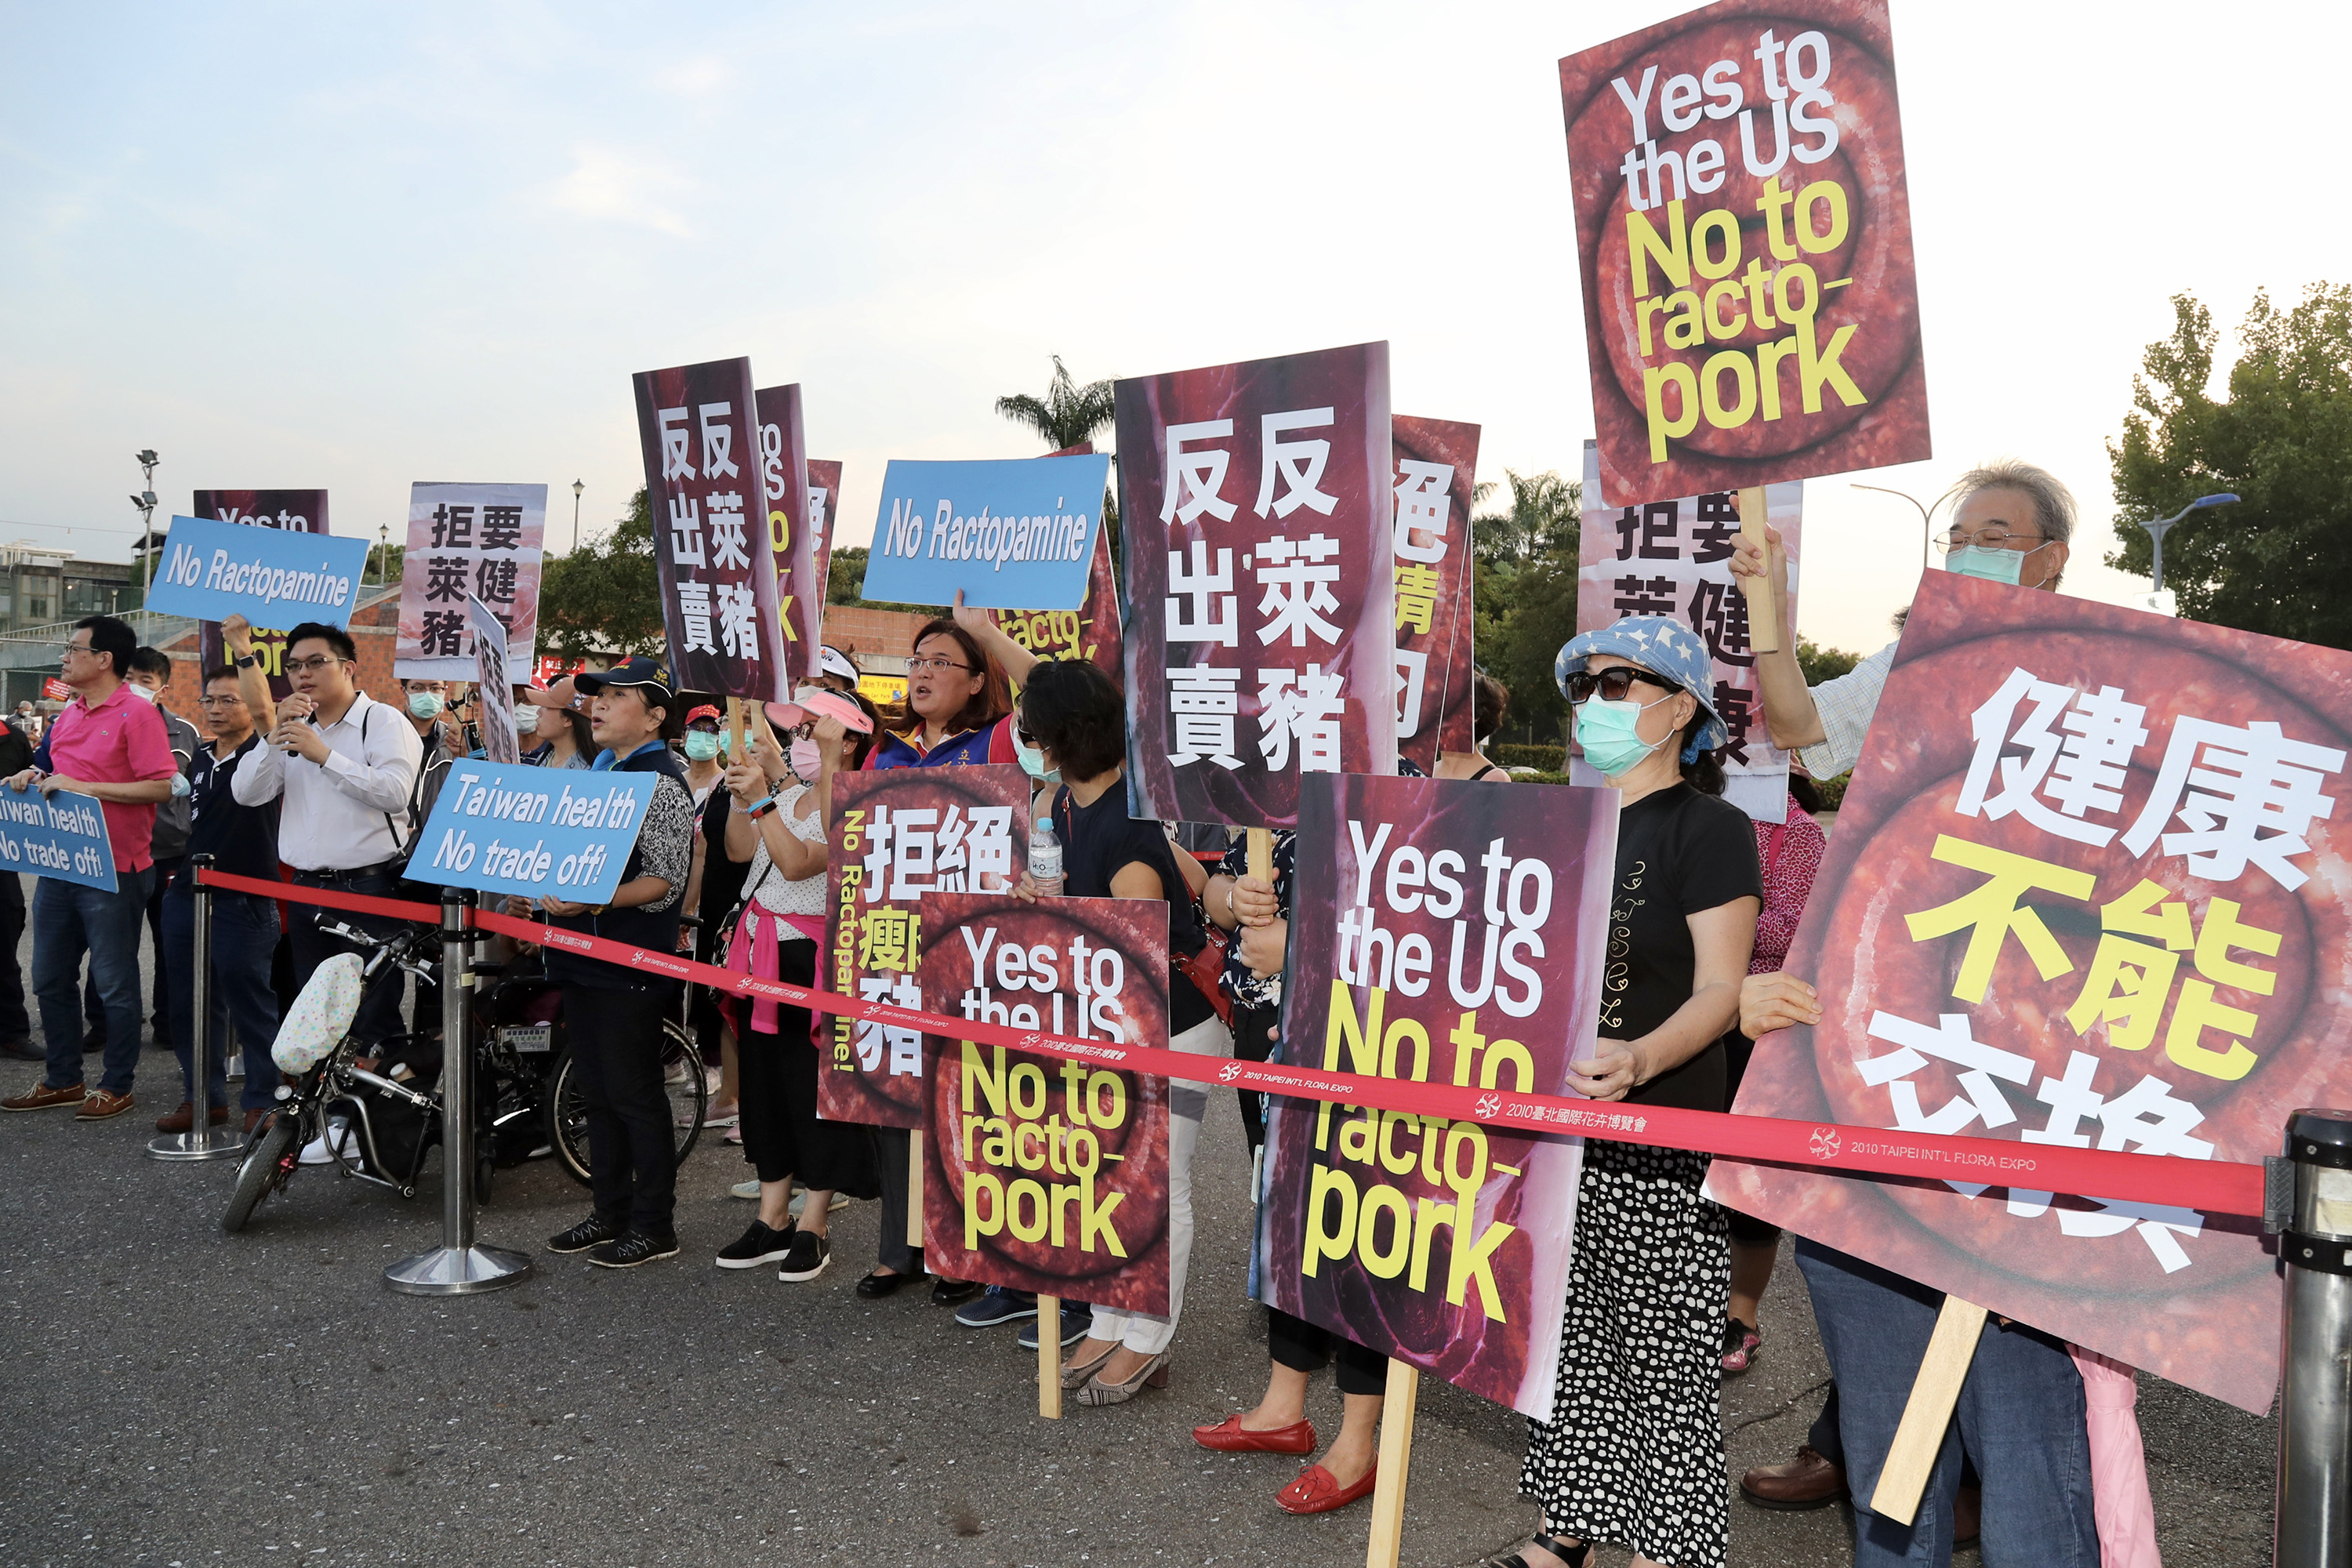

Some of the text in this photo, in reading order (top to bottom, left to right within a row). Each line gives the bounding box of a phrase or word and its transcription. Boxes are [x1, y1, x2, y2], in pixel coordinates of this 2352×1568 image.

[1611, 27, 1831, 145] Yes to
[1620, 88, 1839, 211] the US
[1625, 175, 1849, 298] No to
[1635, 256, 1853, 358] racto-
[1643, 315, 1868, 464] pork
[758, 423, 782, 459] o
[166, 543, 350, 608] No Ractopamine
[420, 503, 474, 657] 拒萊豬
[659, 406, 718, 656] 反出賣
[699, 401, 760, 661] 反萊豬
[768, 510, 789, 552] o
[884, 497, 924, 559] No
[927, 495, 1088, 572] Ractopamine
[1159, 418, 1246, 771] 反出賣
[1254, 406, 1345, 774] 反萊豬
[0, 790, 101, 840] iwan health
[452, 773, 637, 829] Taiwan health
[1954, 666, 2347, 891] 健康
[24, 837, 71, 871] trade
[74, 846, 103, 877] off!
[432, 828, 608, 886] No trade off!
[864, 804, 1012, 903] 拒絕
[1347, 819, 1553, 932] Yes to
[833, 811, 866, 1073] No Ractopaine!
[858, 905, 922, 973] 瘦
[960, 925, 1124, 997] Yes to
[1337, 906, 1433, 997] the
[1447, 920, 1545, 1019] US
[1904, 833, 2283, 1081] 不能
[960, 986, 1040, 1032] the
[1323, 979, 1535, 1094] No to
[961, 1040, 1127, 1130] No to
[1243, 1071, 1353, 1094] 2010 TAIPEI INT'L FLORA EXPO
[1506, 1103, 1647, 1133] 2010臺北國際花卉博覽會
[962, 1113, 1125, 1176] racto-
[1851, 1142, 2037, 1171] 2010 TAIPEI INT'L FLORA EXPO
[1855, 1009, 2215, 1274] 交換
[964, 1171, 1128, 1258] pork
[1301, 1163, 1517, 1323] pork
